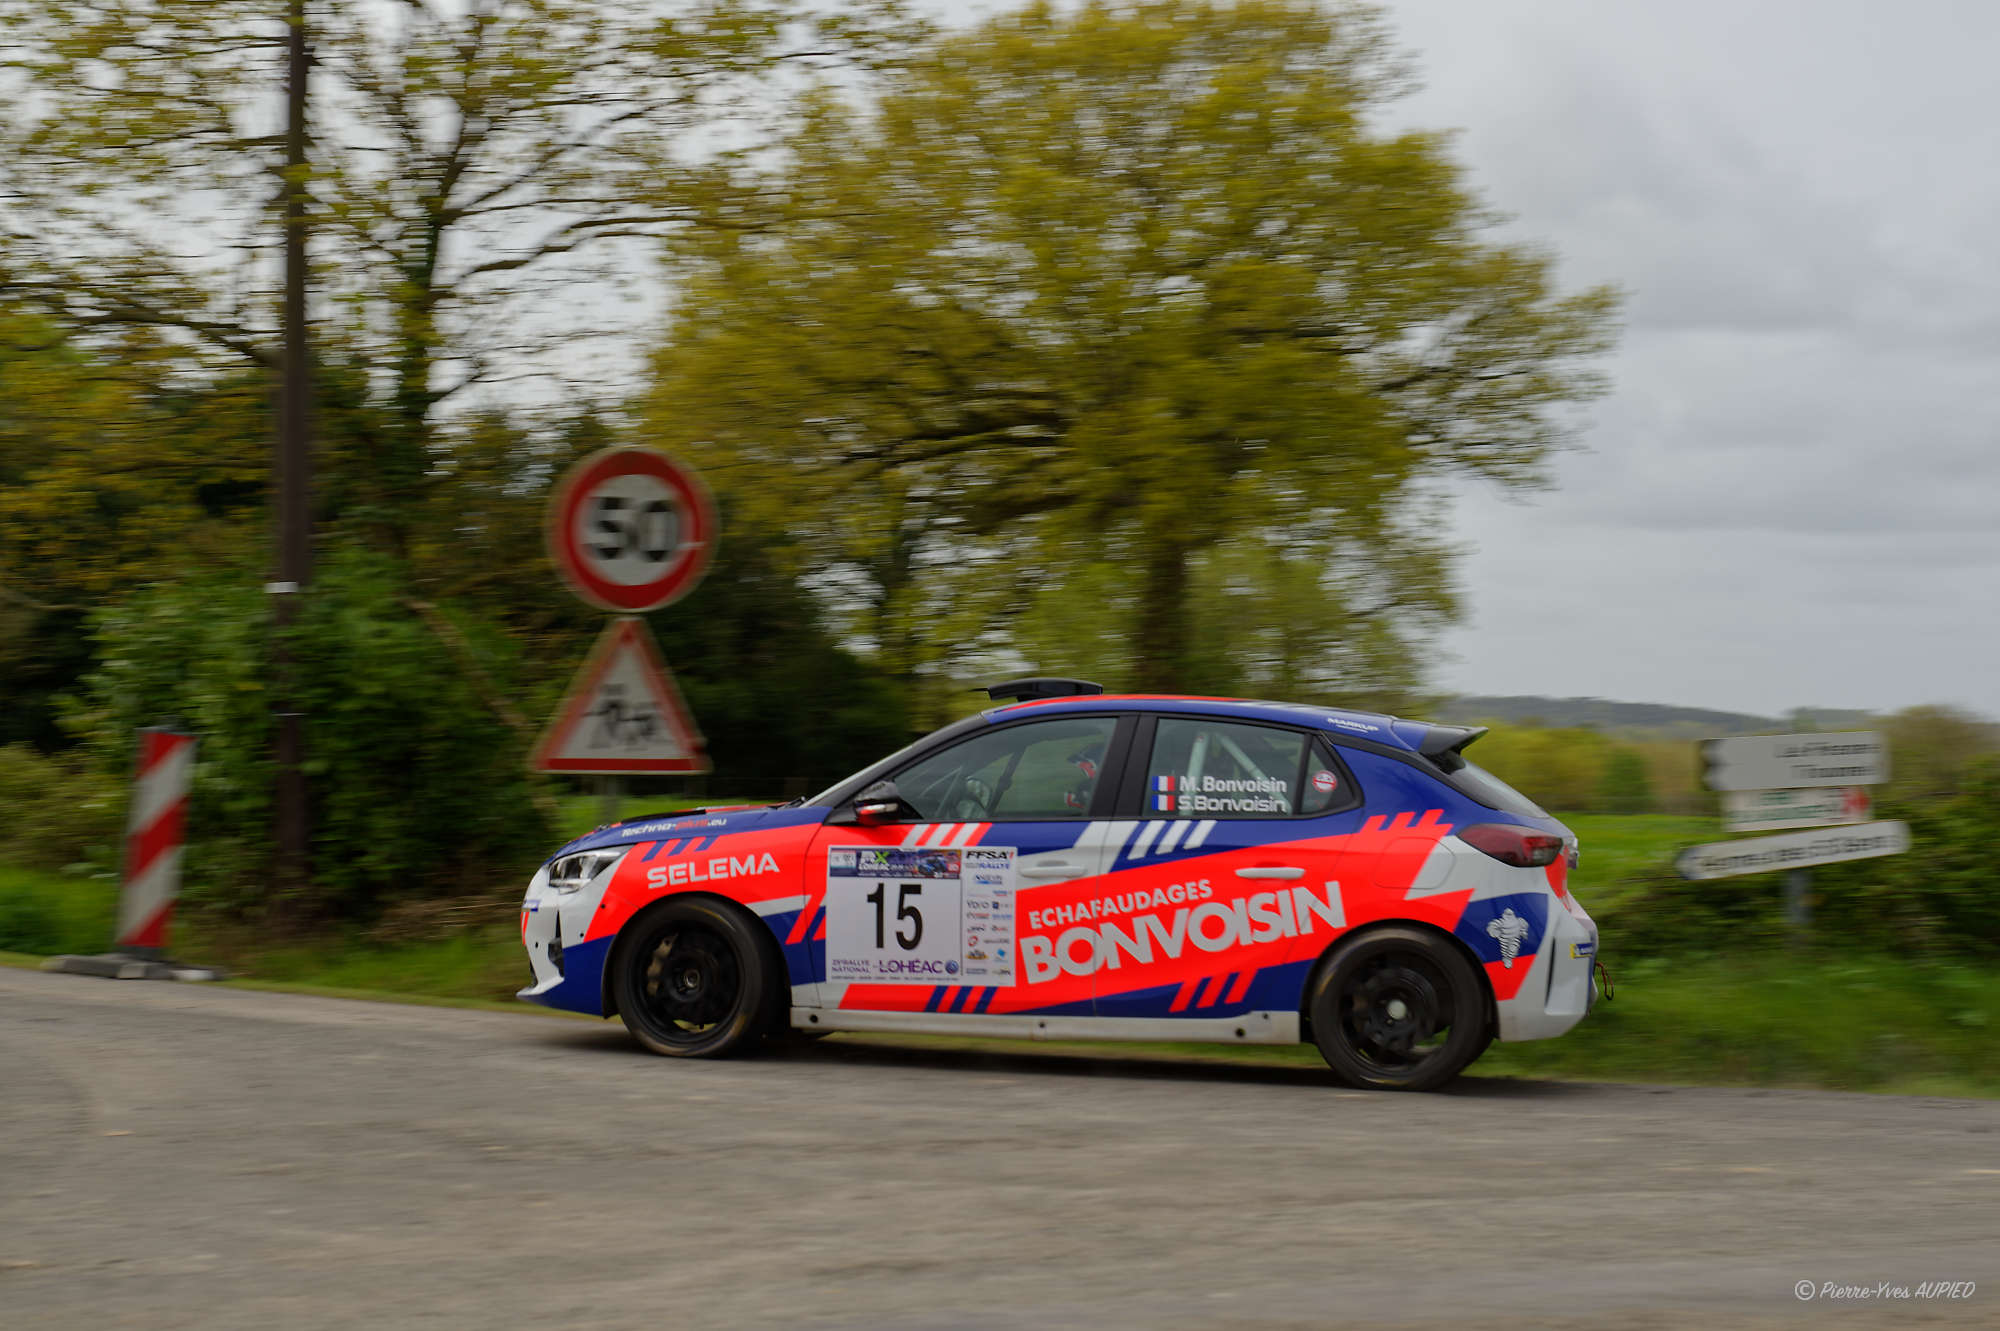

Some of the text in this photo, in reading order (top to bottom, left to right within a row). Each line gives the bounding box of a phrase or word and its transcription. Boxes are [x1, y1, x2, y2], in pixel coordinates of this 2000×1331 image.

[590, 496, 680, 563] 50
[1179, 775, 1287, 793] M. Bonvoisin
[648, 852, 780, 889] SELEMA
[966, 850, 1008, 859] FFSA
[866, 882, 923, 951] 15
[1028, 879, 1213, 930] ECHAFAUDAGES
[1019, 880, 1347, 985] BONVOISIN
[879, 958, 943, 974] LOHÉAC
